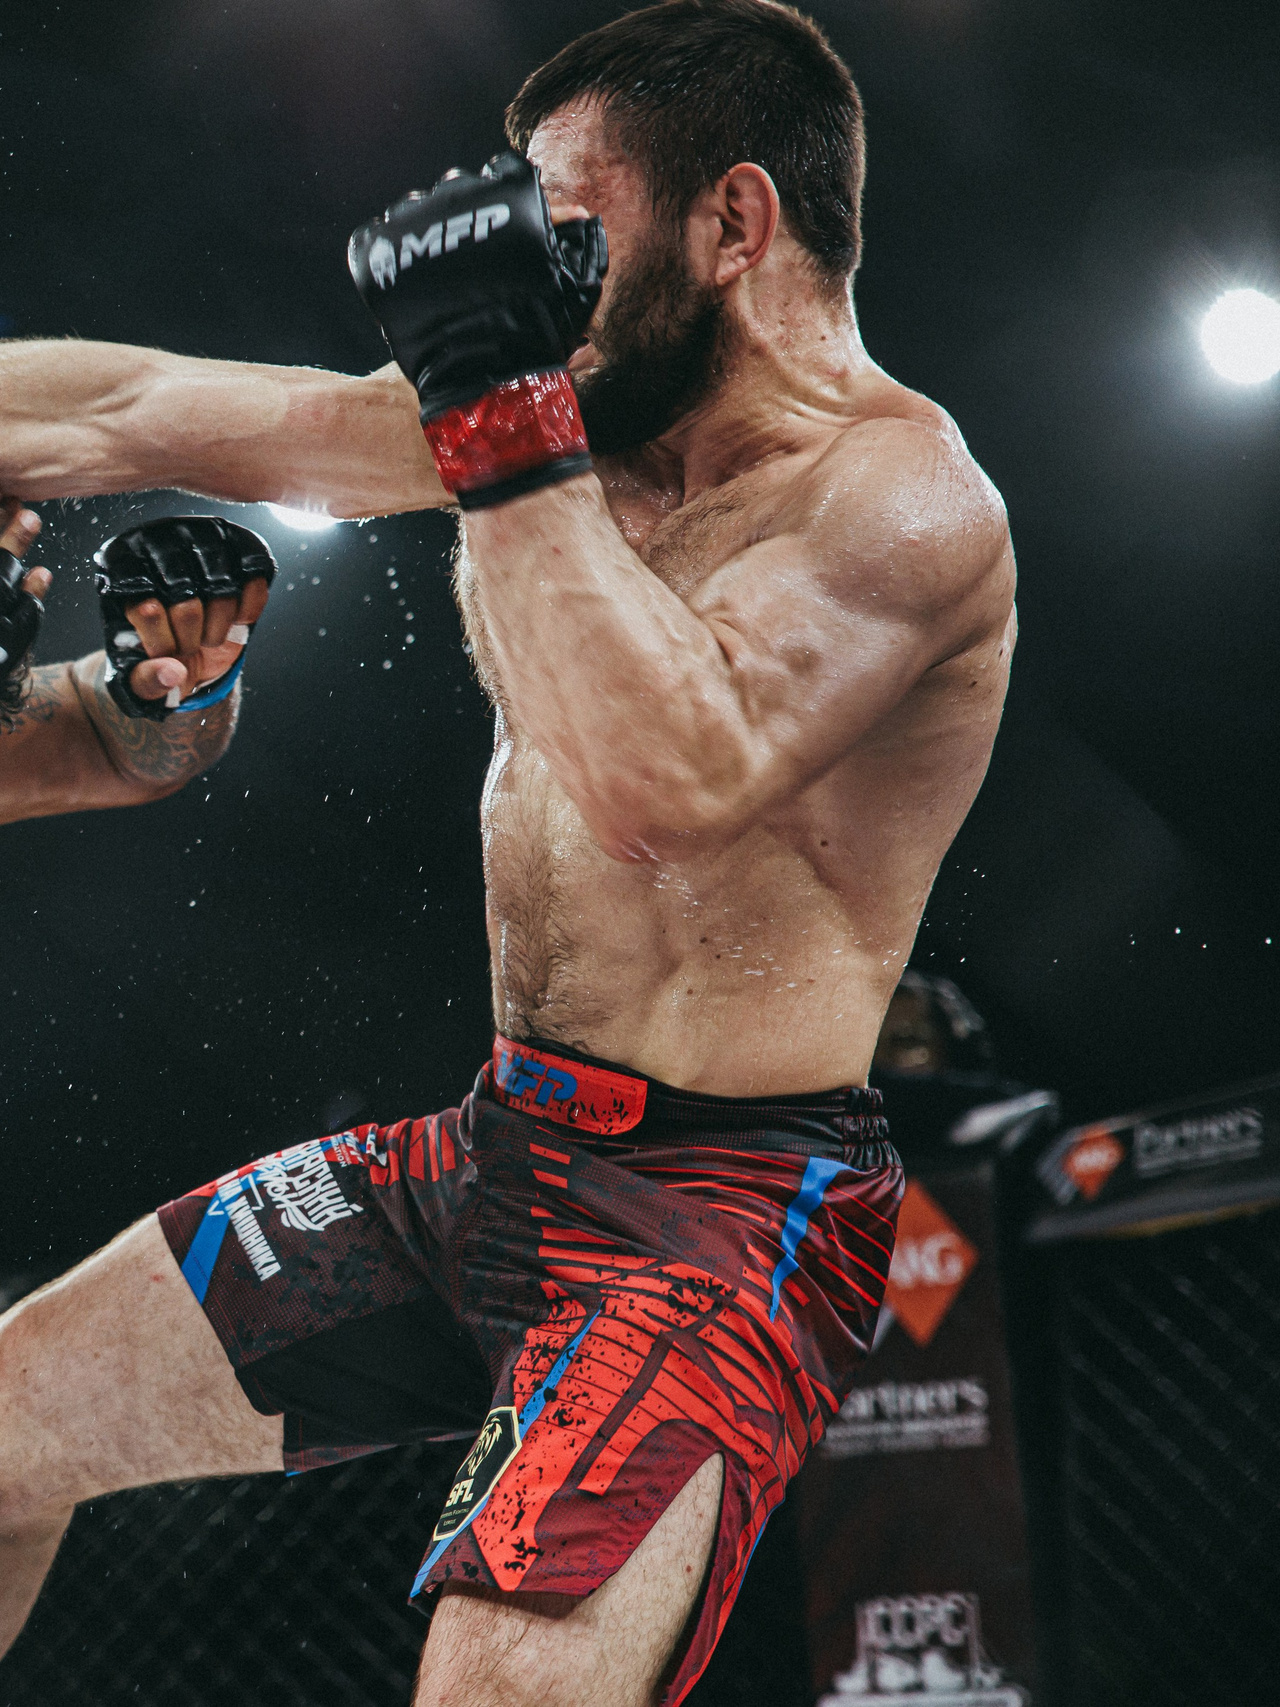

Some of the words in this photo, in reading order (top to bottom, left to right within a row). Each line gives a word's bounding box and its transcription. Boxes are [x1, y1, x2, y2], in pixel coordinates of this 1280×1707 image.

[400, 203, 510, 271] MFP
[218, 1178, 244, 1203] НА
[445, 1478, 474, 1507] SFL
